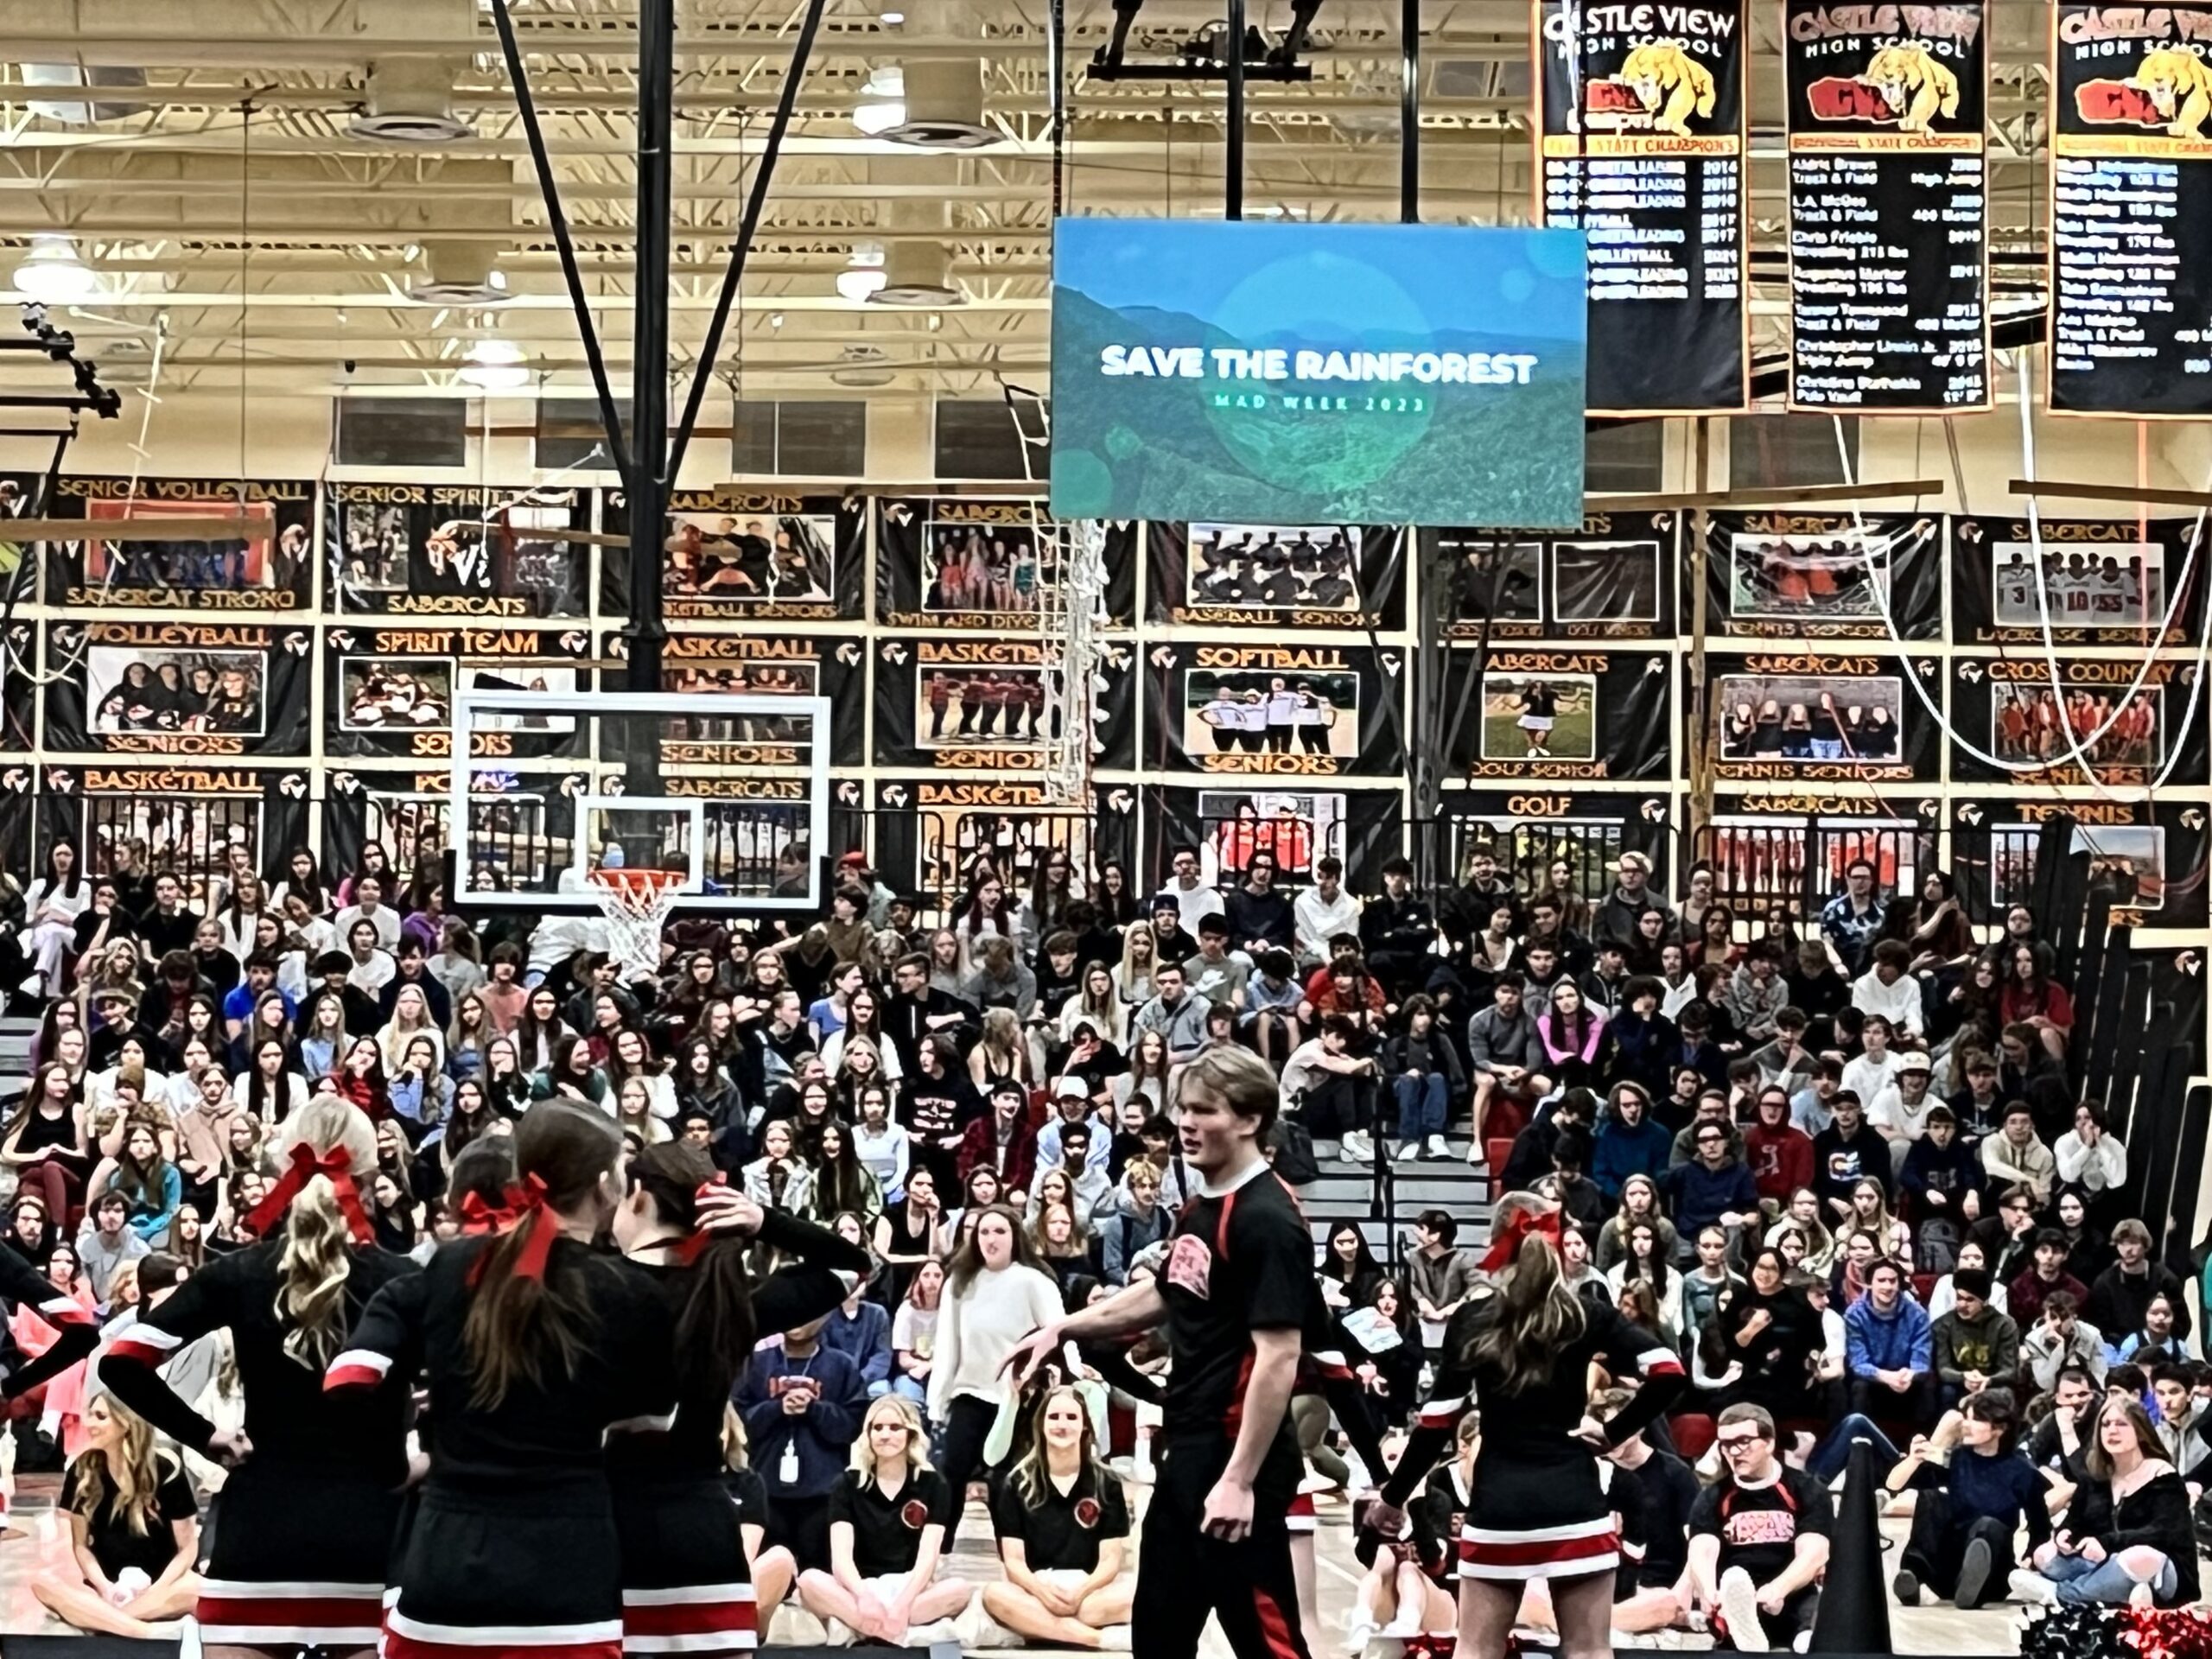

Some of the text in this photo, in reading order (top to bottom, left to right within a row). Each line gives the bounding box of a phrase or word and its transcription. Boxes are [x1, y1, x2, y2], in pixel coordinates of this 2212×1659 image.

[1657, 5, 1735, 37] VIEW
[1101, 345, 1538, 385] SAVE THE RAINFOREST
[1214, 394, 1266, 409] MAD
[387, 596, 526, 615] SABERCATS
[87, 623, 273, 646] VOLLEYBALL
[375, 632, 540, 653] SPIRIT TEAM
[662, 638, 819, 660] ASKETBALL
[1196, 647, 1350, 671] SOFTBALL
[1484, 653, 1609, 674] ABERCATS
[1744, 656, 1880, 674] SABERCATS
[105, 736, 245, 755] SENIORS
[1203, 753, 1338, 775] SENIORS
[85, 770, 265, 791] BASKETBALL
[664, 777, 804, 798] SABERCATS
[1507, 795, 1573, 816] GOLF
